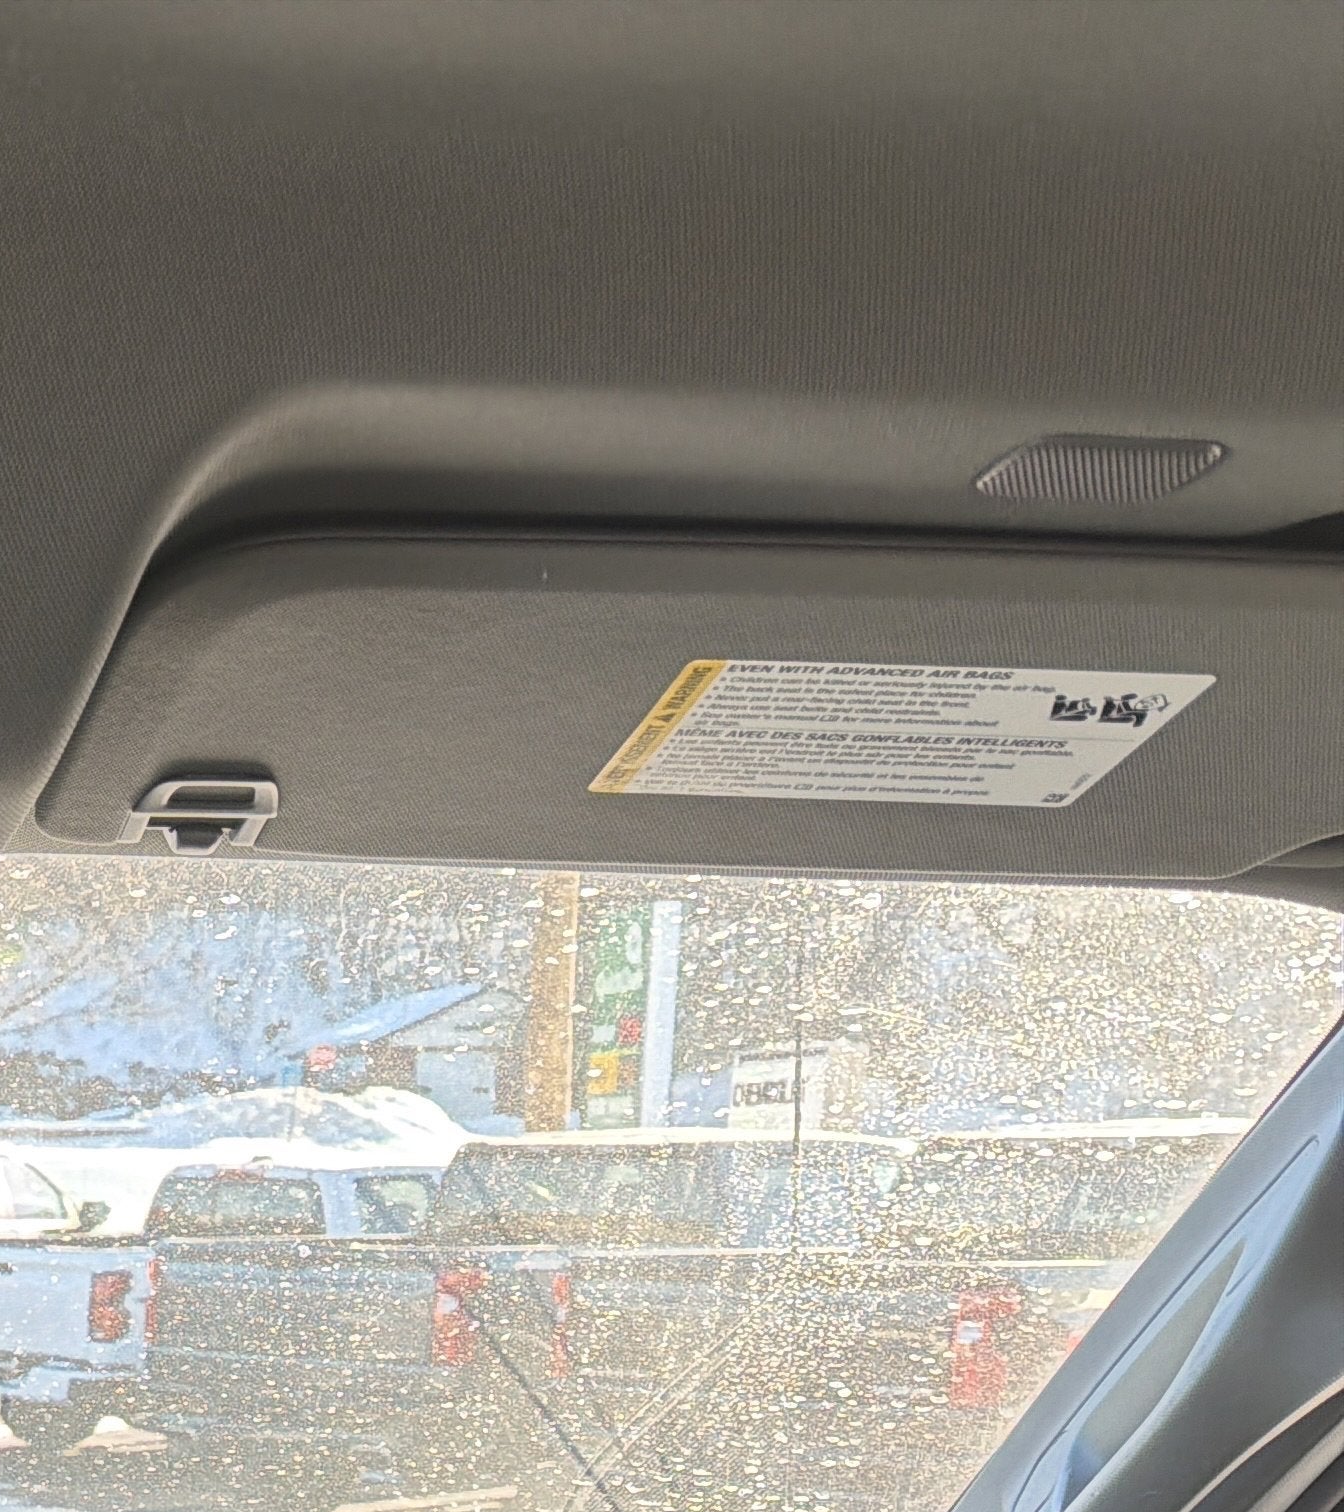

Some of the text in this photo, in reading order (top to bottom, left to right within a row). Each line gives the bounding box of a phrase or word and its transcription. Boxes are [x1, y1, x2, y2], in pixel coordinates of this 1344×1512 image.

[727, 664, 773, 672] EVEN
[826, 667, 923, 676] ADVANCED
[962, 671, 1013, 679] BAGS
[675, 728, 722, 736] MÊME
[851, 734, 954, 743] GONFLABLES
[956, 737, 1068, 747] INTELLIGENTS
